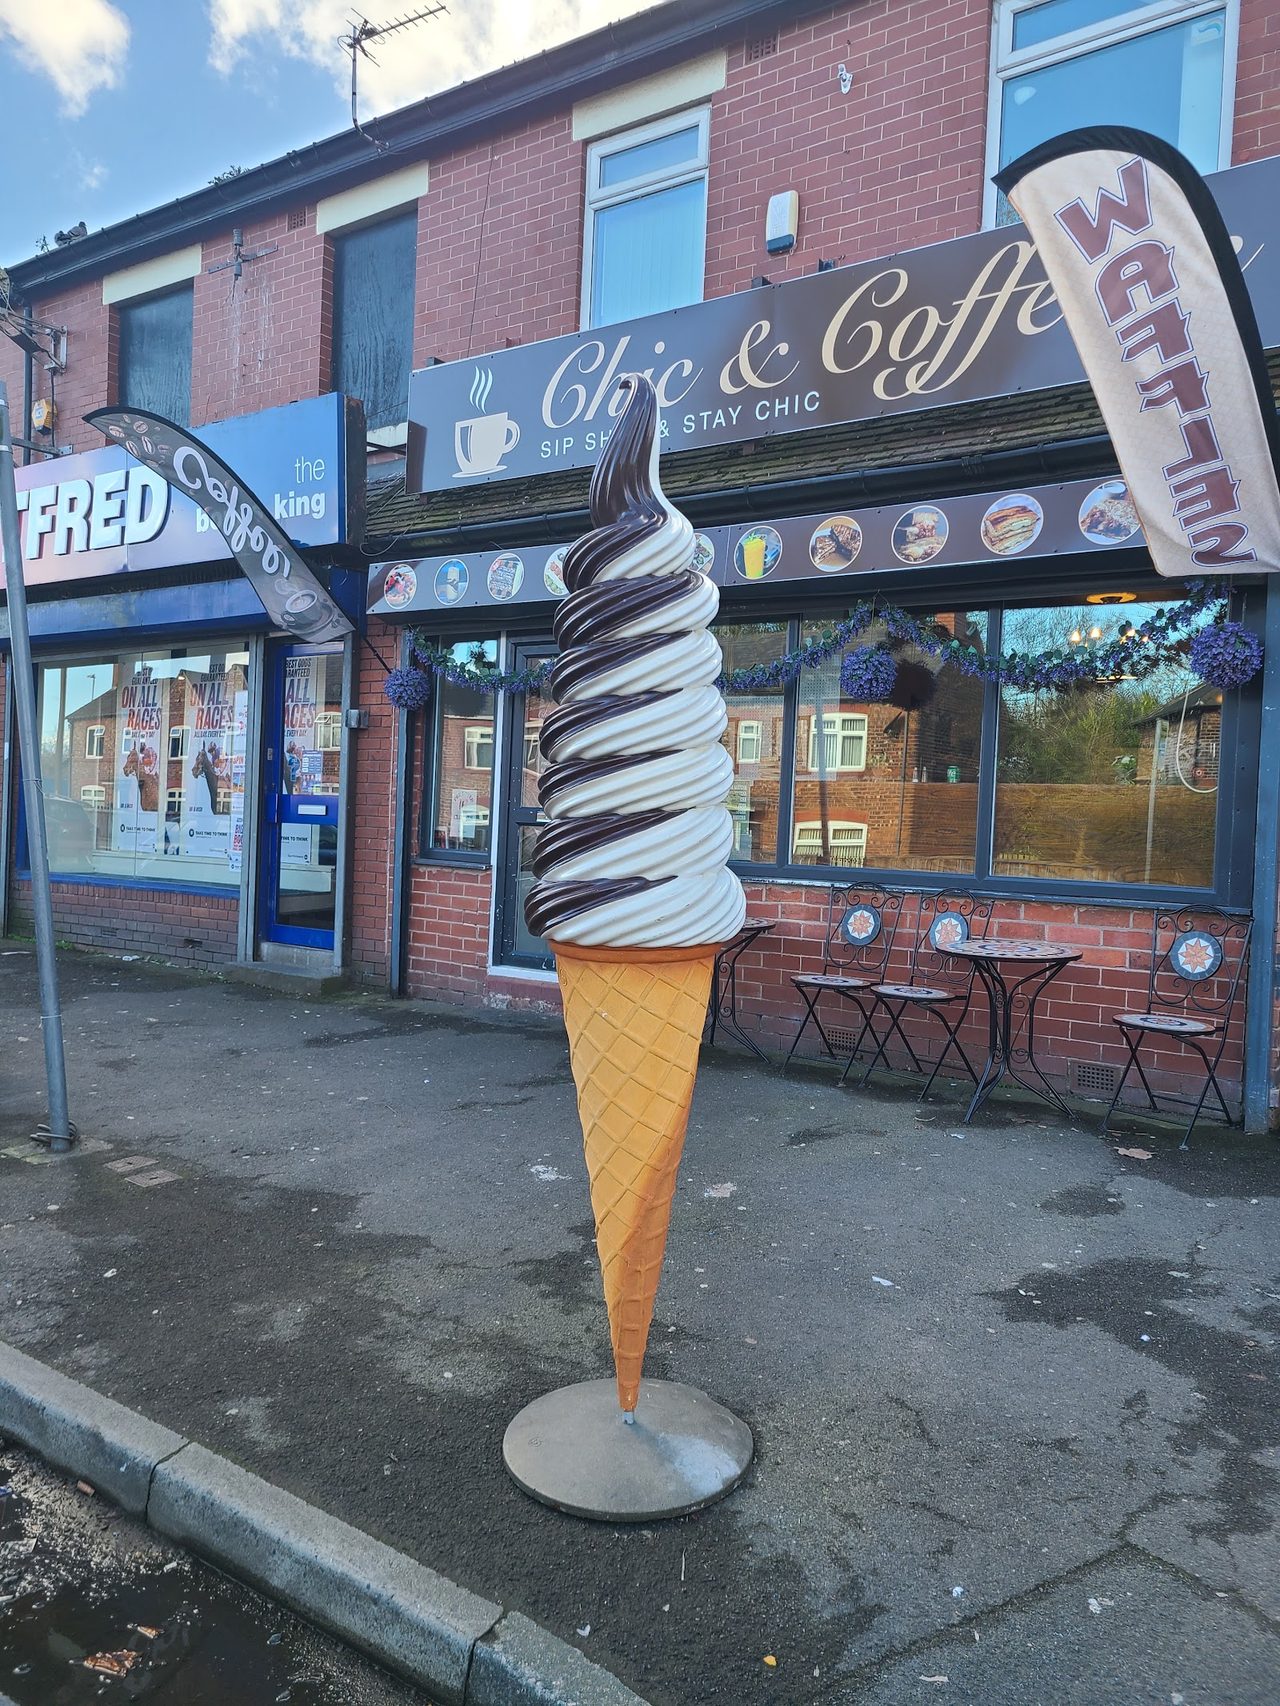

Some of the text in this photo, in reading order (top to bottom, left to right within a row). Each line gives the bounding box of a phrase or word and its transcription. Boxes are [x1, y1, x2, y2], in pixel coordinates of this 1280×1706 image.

[719, 320, 800, 394] &
[821, 240, 1066, 401] Coffe
[540, 391, 820, 458] SIP SH & STAY CHIC
[295, 456, 325, 483] the
[274, 490, 326, 520] king
[122, 685, 158, 708] ON ALL
[190, 683, 206, 706] ON
[127, 708, 162, 730] RACES
[195, 705, 234, 729] RACES
